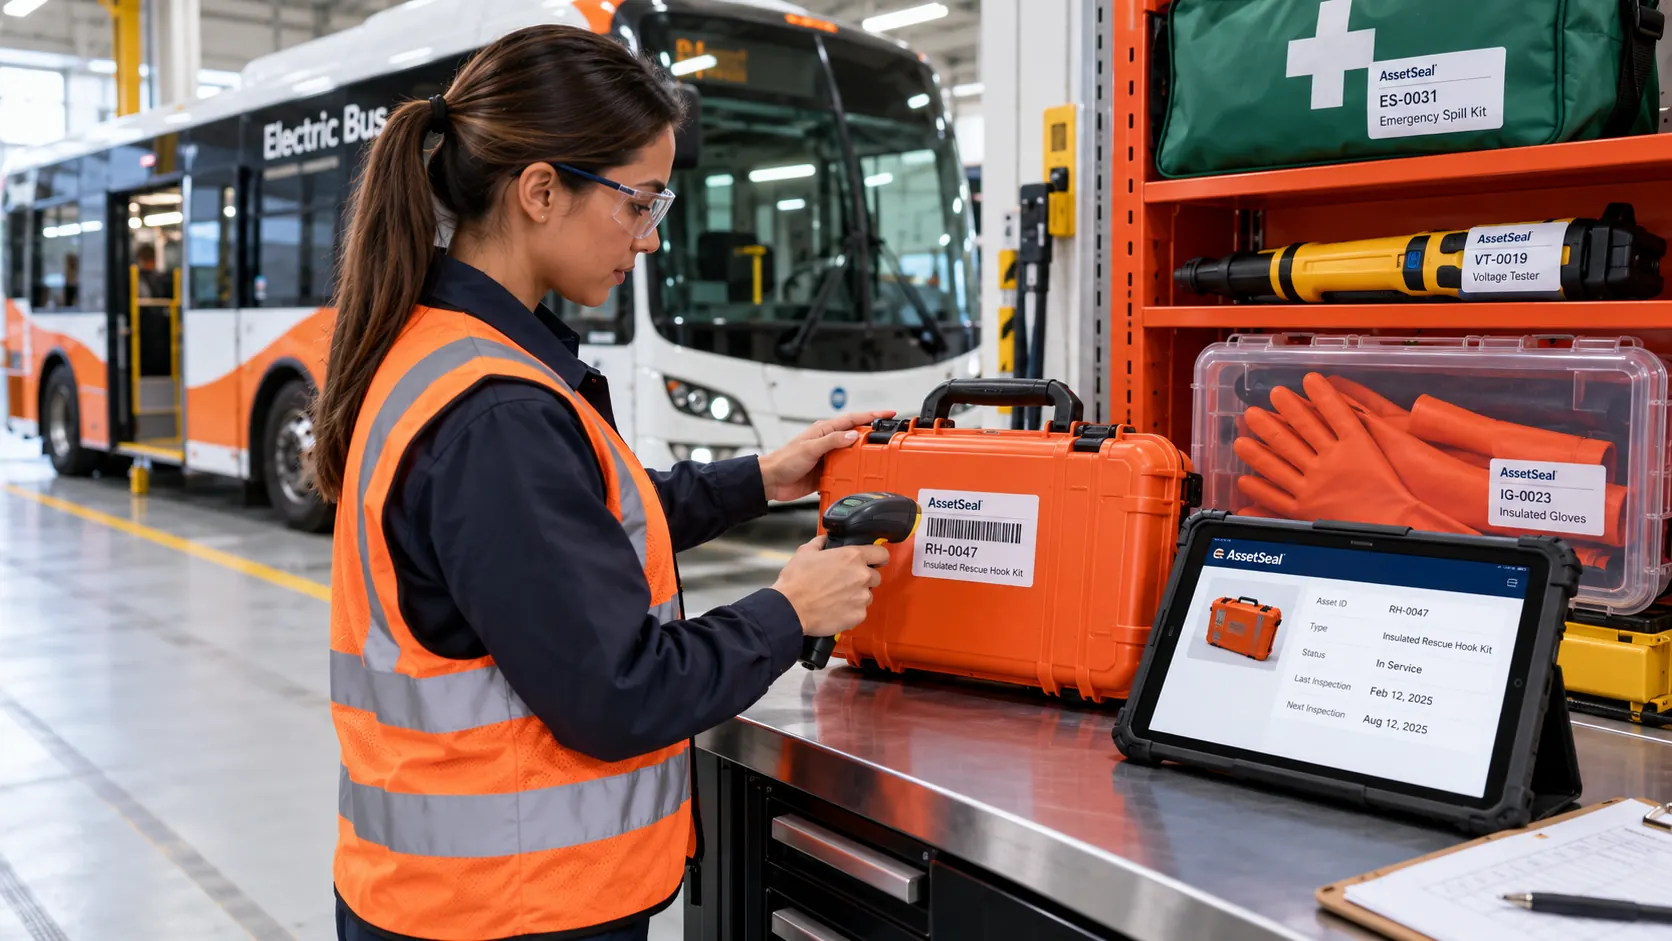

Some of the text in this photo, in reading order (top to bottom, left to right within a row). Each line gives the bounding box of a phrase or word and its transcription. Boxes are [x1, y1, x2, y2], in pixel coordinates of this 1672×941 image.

[1379, 64, 1435, 81] AssetSeal
[1380, 89, 1437, 108] ES-0031
[1380, 106, 1487, 127] Emergency Spill Kit
[263, 104, 388, 160] Electric Bus
[1477, 231, 1531, 244] AssetSeal
[1475, 252, 1528, 265] VT-0019
[1473, 271, 1540, 284] Voltage Tester
[1500, 467, 1556, 480] AssetSeal
[1500, 489, 1552, 503] IG-0023
[928, 497, 981, 511] AssetSeal
[1500, 507, 1587, 524] Insulated Gloves
[925, 543, 978, 558] RH-0047
[1226, 549, 1284, 565] AssetSeal
[923, 560, 1024, 577] Insulated Rescue Hook Kit
[1316, 597, 1348, 608] Asset ID
[1389, 604, 1429, 617] RH-0047
[1310, 622, 1328, 632] Type
[1382, 632, 1492, 654] Insulated Rescue Hook Kit
[1302, 648, 1326, 659] Status
[1376, 659, 1422, 674] In Service
[1294, 674, 1352, 691] Last Inspection
[1369, 686, 1433, 706] Feb 12, 2025
[1286, 700, 1346, 719] Next Inspection
[1362, 714, 1428, 735] Aug 12, 2025
